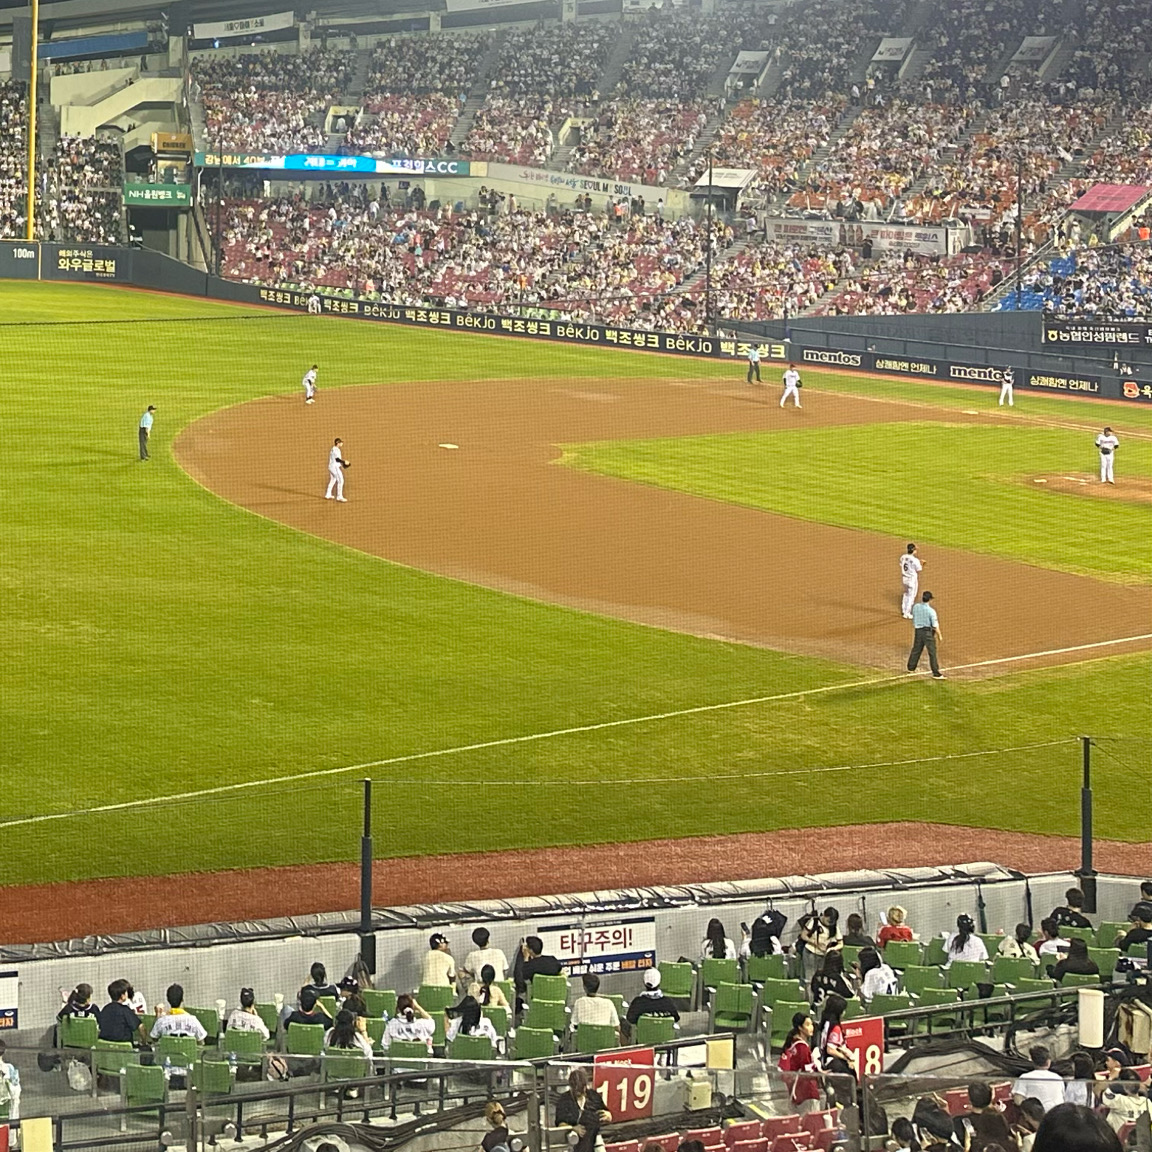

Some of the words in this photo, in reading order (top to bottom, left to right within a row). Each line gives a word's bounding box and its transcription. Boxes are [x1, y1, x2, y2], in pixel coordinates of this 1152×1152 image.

[13, 248, 35, 259] 100m
[58, 258, 116, 273] 와우글로벌
[260, 289, 291, 305] 백조씽크
[324, 299, 359, 314] 백조씽크
[405, 309, 452, 326] 백조씽크
[501, 318, 551, 336] 백조씽크
[605, 329, 660, 348] 백조씽크
[803, 349, 861, 366] mentos
[910, 362, 938, 375] 언제나
[950, 366, 1003, 382] mento
[1069, 378, 1098, 393] 언제나
[560, 928, 633, 953] 타구주의!
[852, 1044, 882, 1079] 18
[596, 1074, 652, 1112] 119
